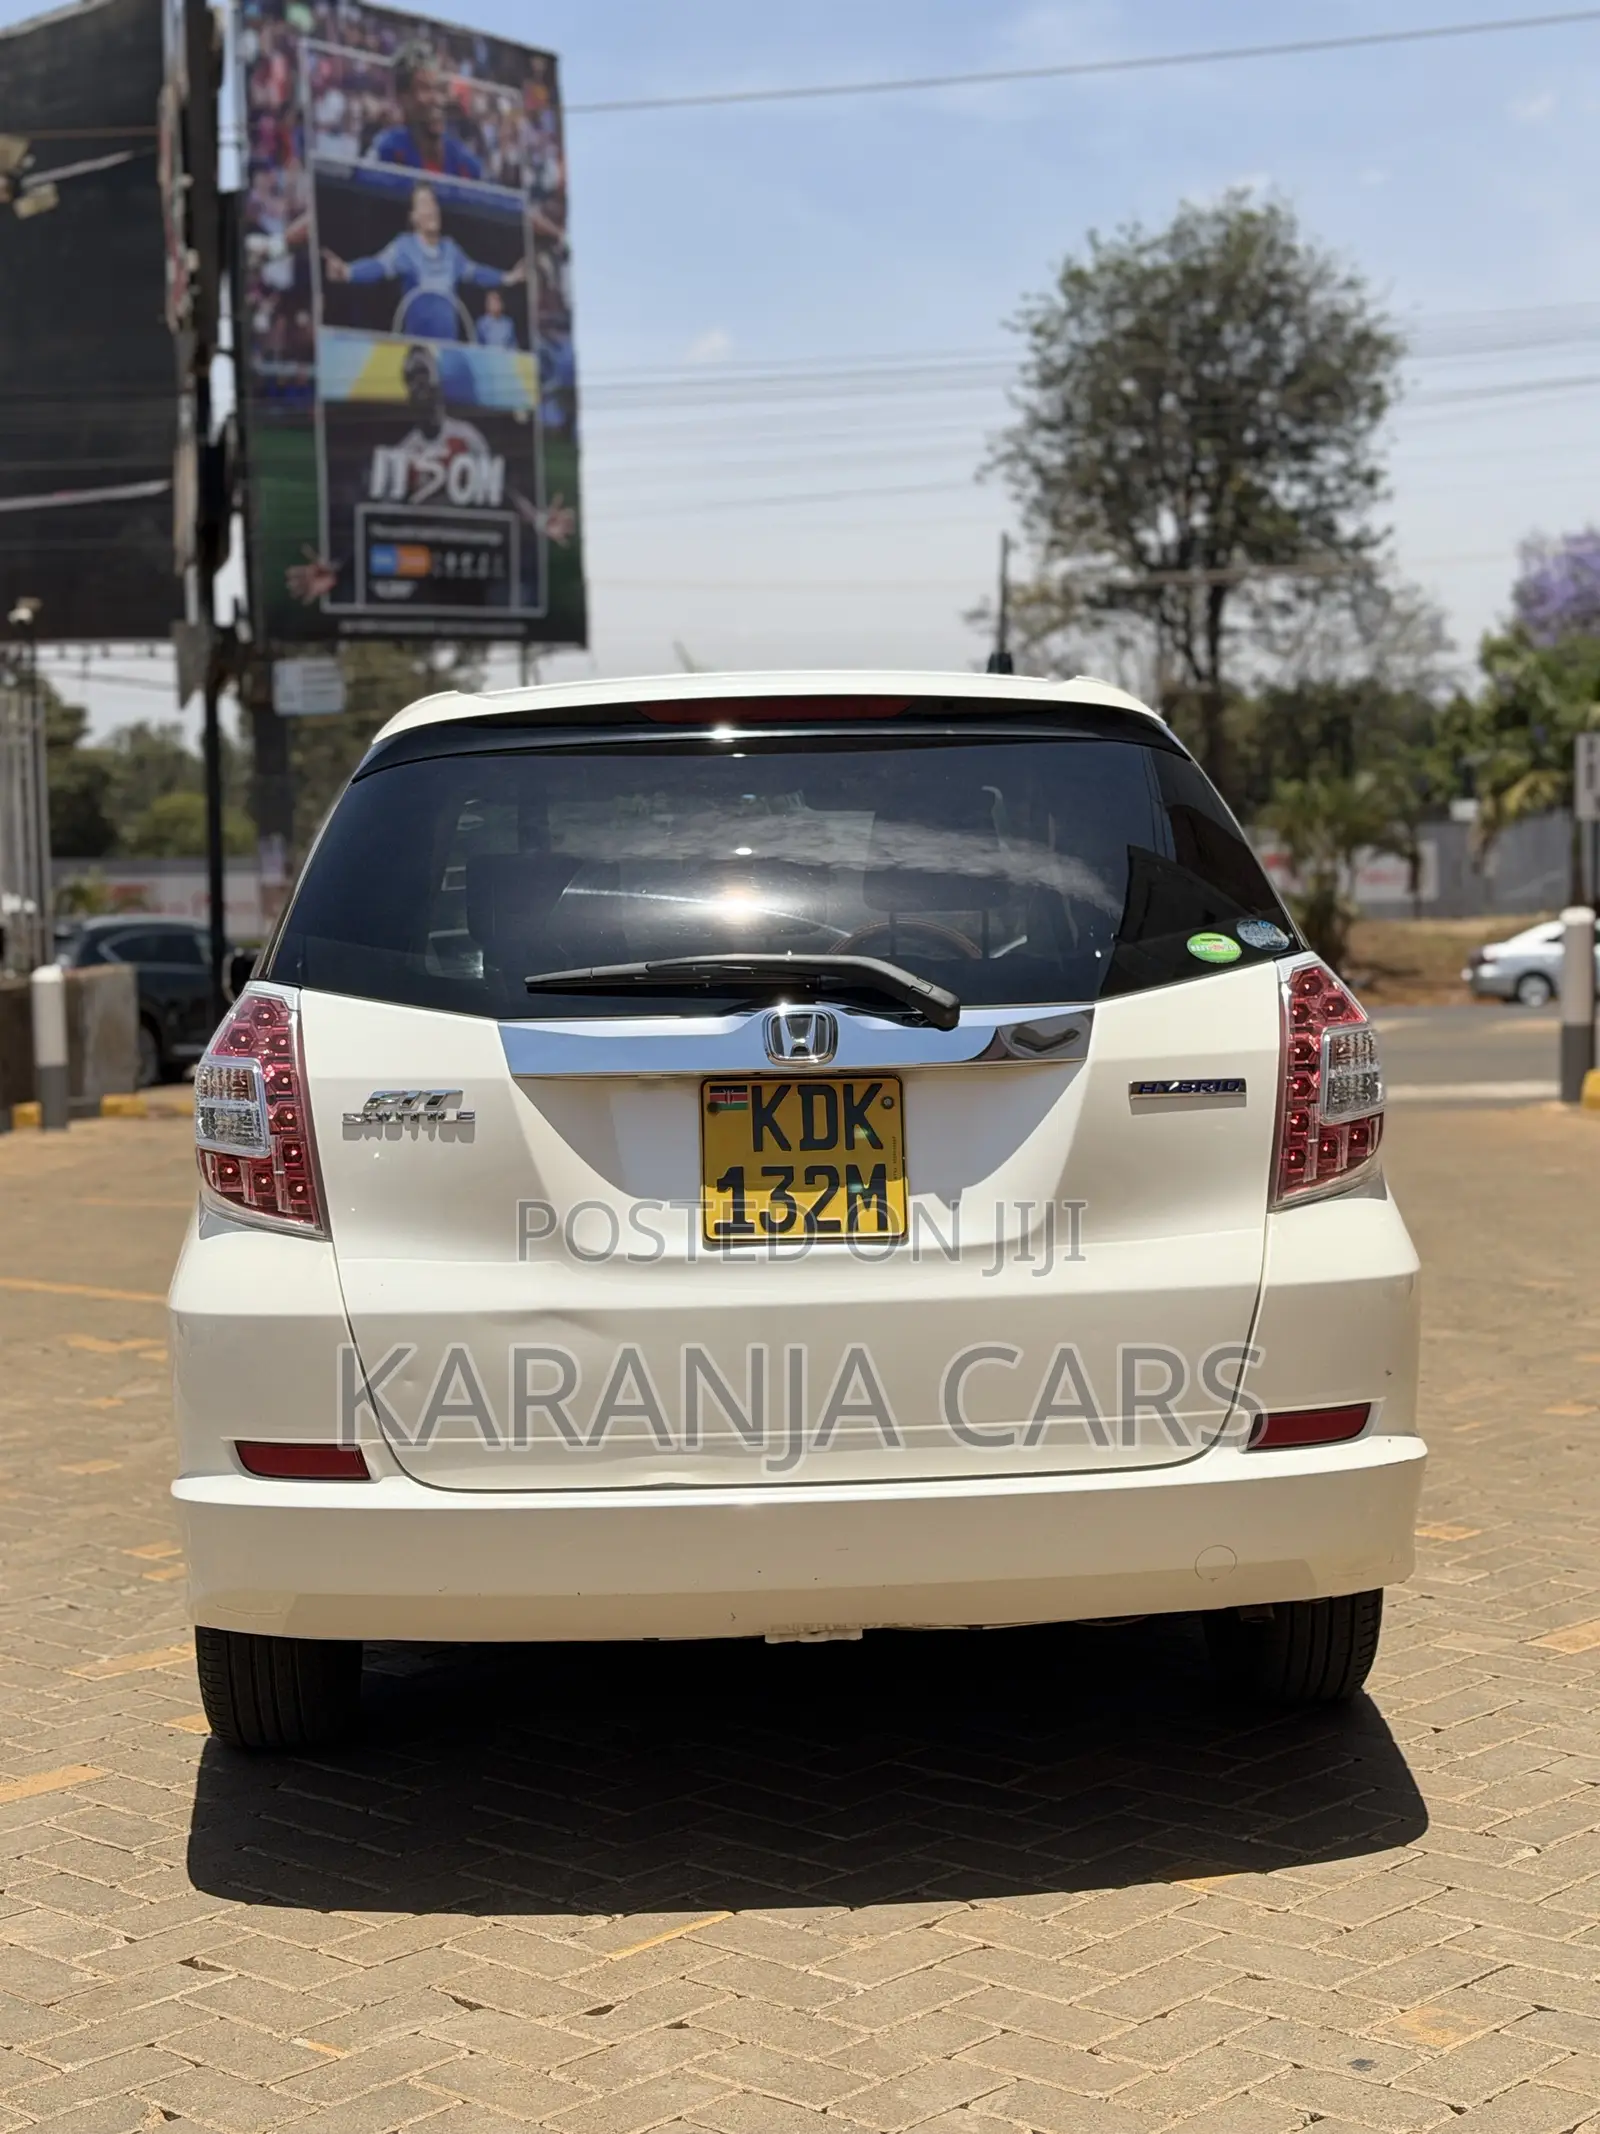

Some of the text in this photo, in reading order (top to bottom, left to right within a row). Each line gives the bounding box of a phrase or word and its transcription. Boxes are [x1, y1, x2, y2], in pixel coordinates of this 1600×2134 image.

[362, 1089, 463, 1110] FIT
[751, 1083, 884, 1152] KDK
[714, 1163, 889, 1235] 132M
